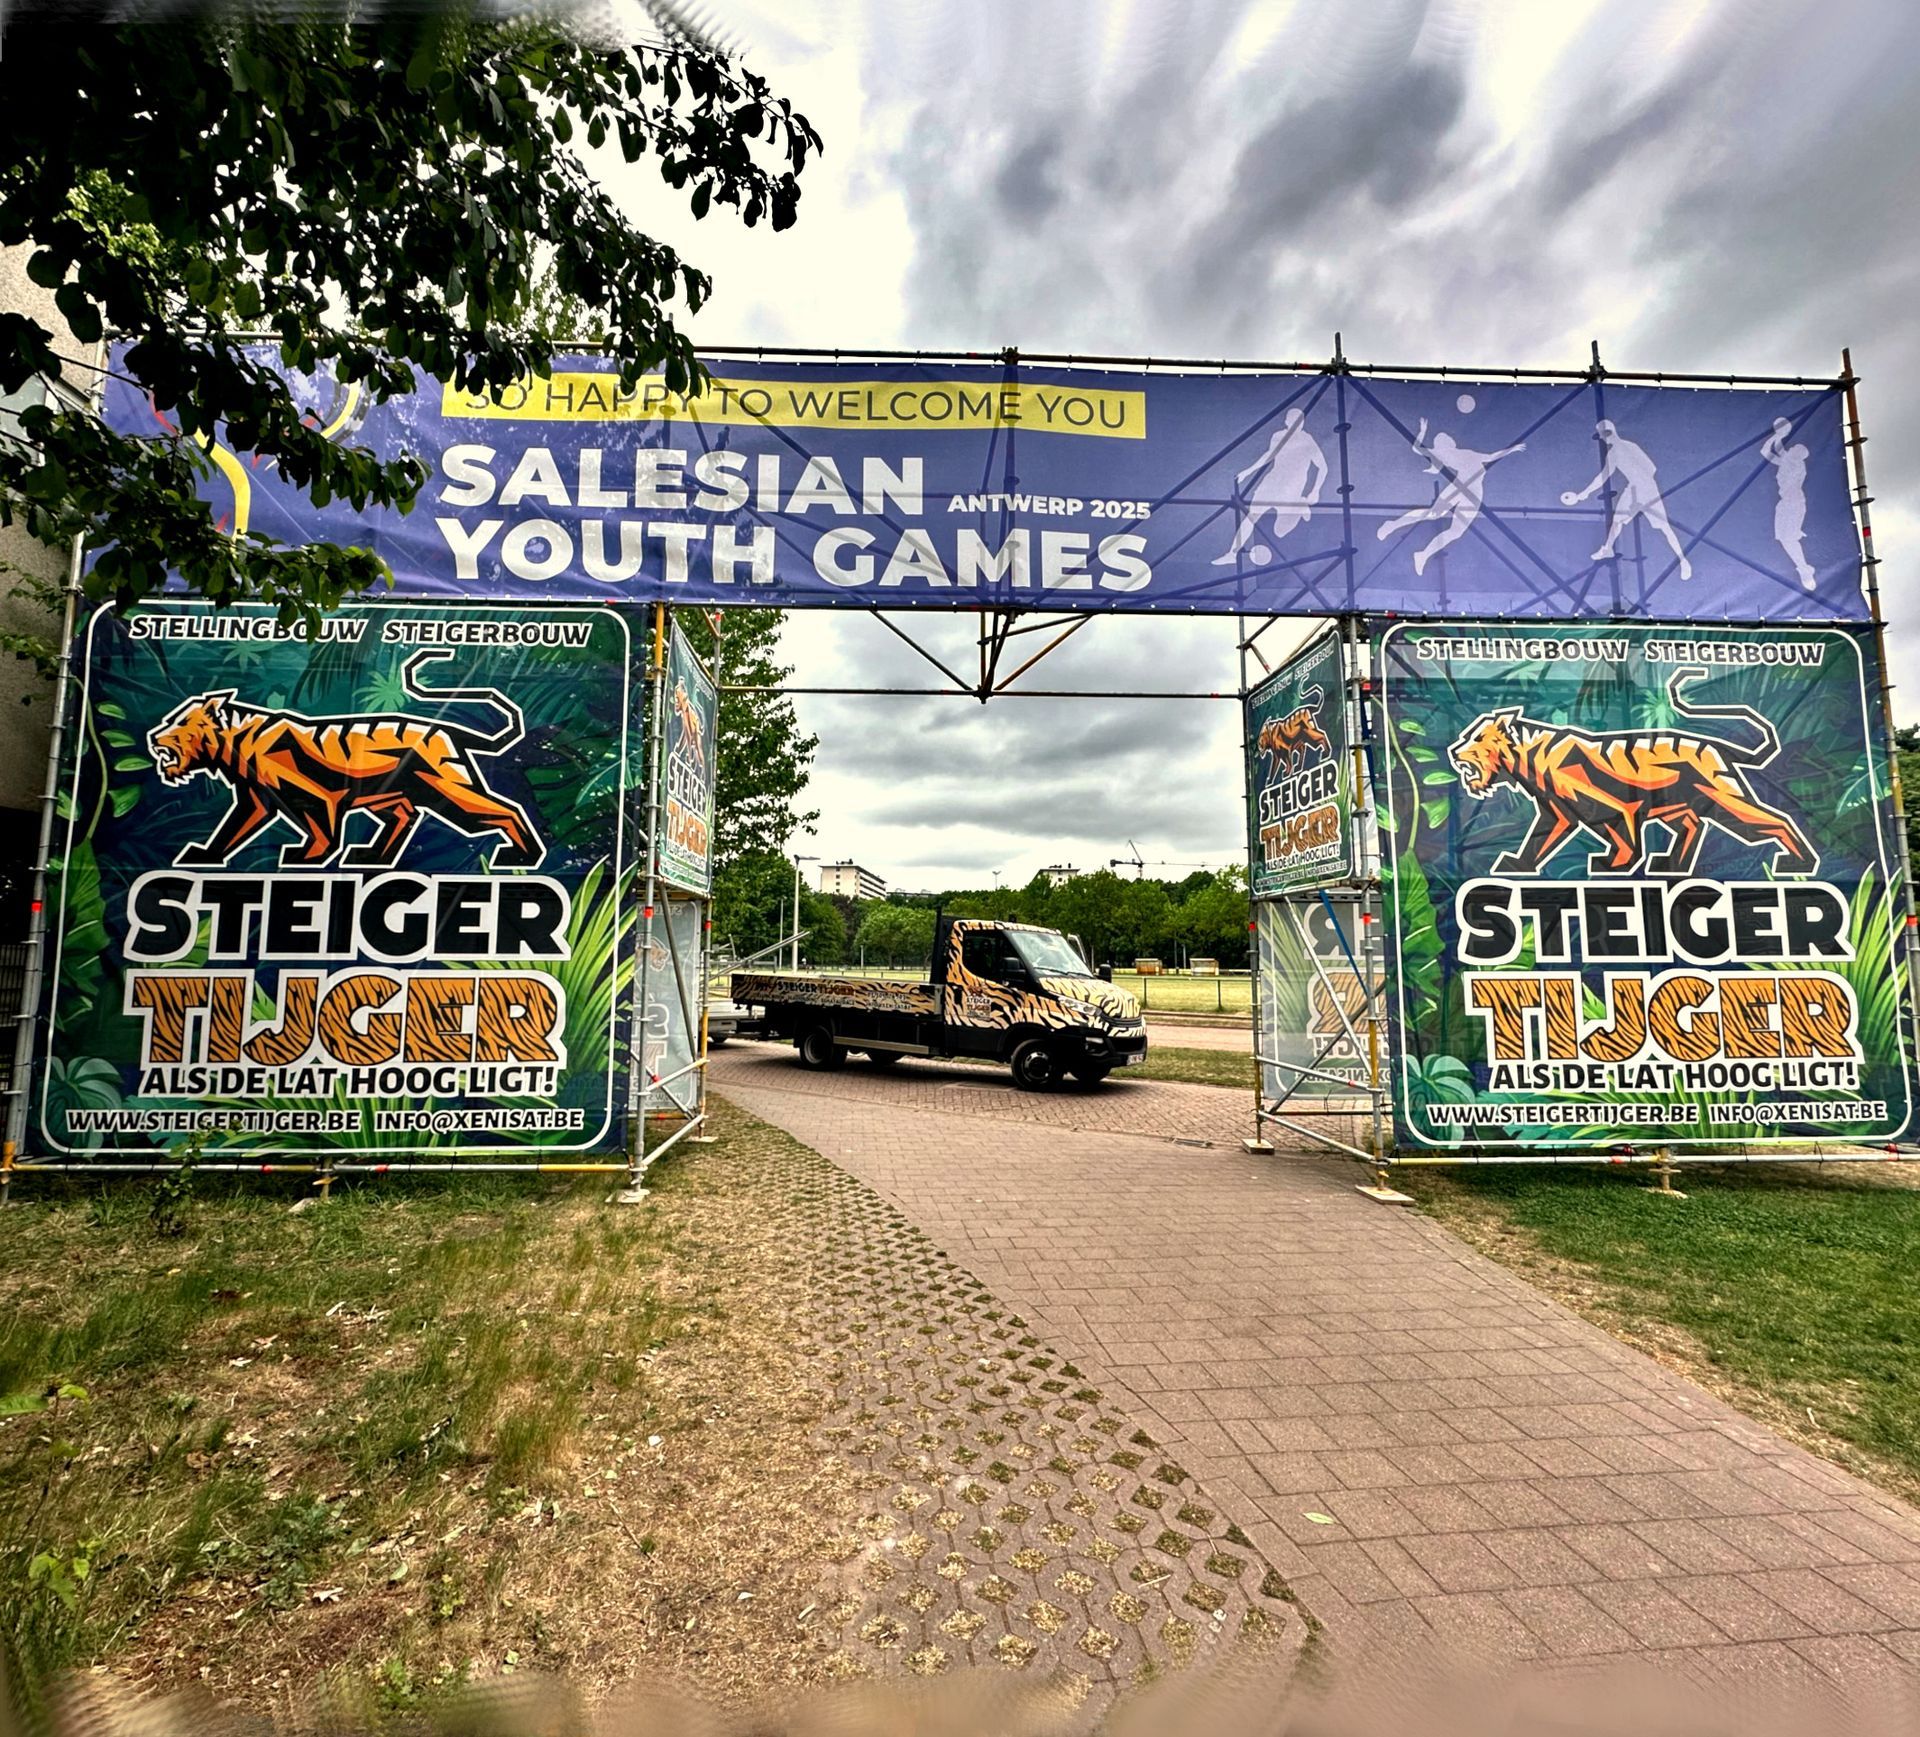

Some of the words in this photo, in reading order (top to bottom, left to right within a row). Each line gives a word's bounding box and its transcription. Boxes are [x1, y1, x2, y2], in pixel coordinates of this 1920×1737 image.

[719, 387, 773, 418] TO
[789, 389, 1022, 422] WELCOME
[1036, 392, 1126, 430] YOU
[440, 443, 923, 516] SALESIAN
[947, 494, 1084, 518] ANTWERP
[1089, 499, 1151, 521] 2025
[435, 517, 776, 585] YOUTH
[812, 527, 1152, 592] GAMES
[130, 614, 368, 643] STELLINGBOUW
[383, 621, 592, 647] STEIGERBOUW
[1417, 639, 1628, 662] STELLINGBOUW
[1646, 642, 1825, 666] STEIGERBOUW
[1260, 760, 1339, 824] STEIGER
[1261, 803, 1341, 861] TIJGER
[126, 873, 569, 961] STEIGER
[1460, 881, 1853, 963] STEIGER
[127, 970, 565, 1068] TIJGER
[1467, 972, 1860, 1064] TIJGER
[143, 1067, 208, 1095] ALS
[220, 1067, 273, 1095] DE
[277, 1067, 337, 1095] LAT
[350, 1067, 458, 1095] HOOG
[470, 1067, 556, 1094] LIGT!
[1493, 1063, 1549, 1089] ALS
[1561, 1063, 1606, 1089] DE
[1617, 1063, 1674, 1089] LAT
[1686, 1062, 1773, 1088] HOOG
[1780, 1061, 1857, 1087] LIGT!
[67, 1110, 361, 1133] WWW.STEIGERTIJGER.BE
[374, 1109, 584, 1134] INFO@XENISAT.BE
[1429, 1104, 1699, 1125] WWW.STEIGERTIJGER.BE
[1710, 1101, 1888, 1123] INFO@XENISAT.BE
